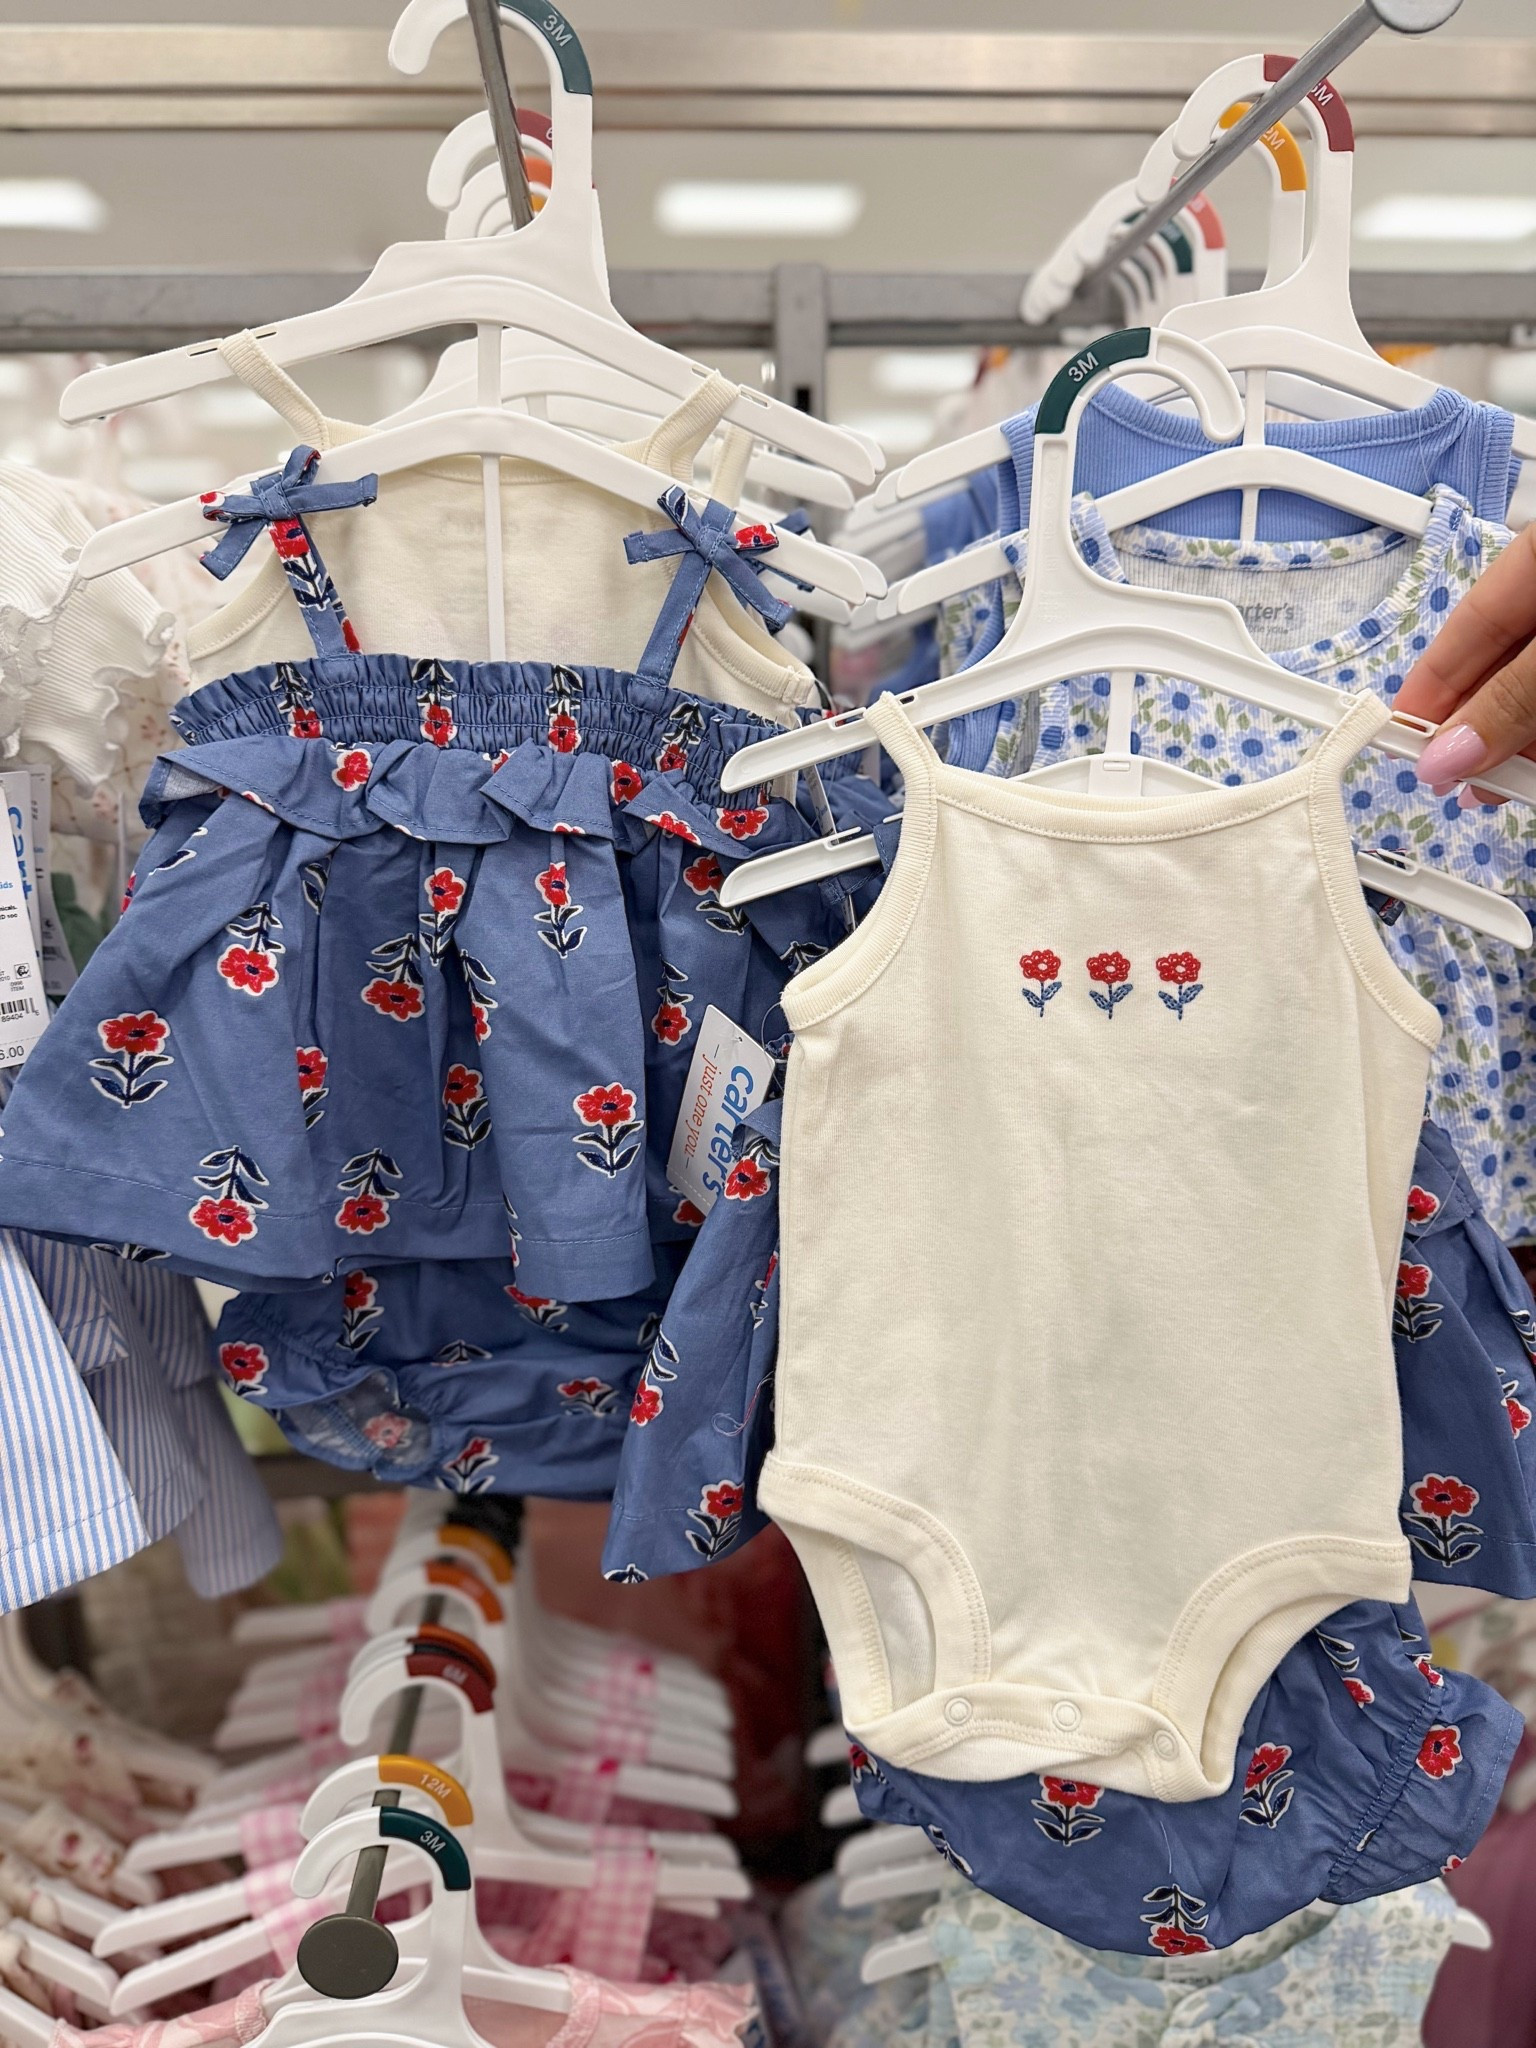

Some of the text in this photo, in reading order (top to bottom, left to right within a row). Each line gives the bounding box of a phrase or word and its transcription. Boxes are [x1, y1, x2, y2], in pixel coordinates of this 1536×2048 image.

[543, 14, 573, 47] 3M
[1068, 351, 1099, 382] 3M
[1236, 602, 1295, 621] arter's
[700, 1053, 722, 1097] just
[692, 1094, 708, 1127] one
[703, 1065, 754, 1197] carters
[420, 1773, 453, 1799] 12M
[420, 1830, 447, 1853] 3M
